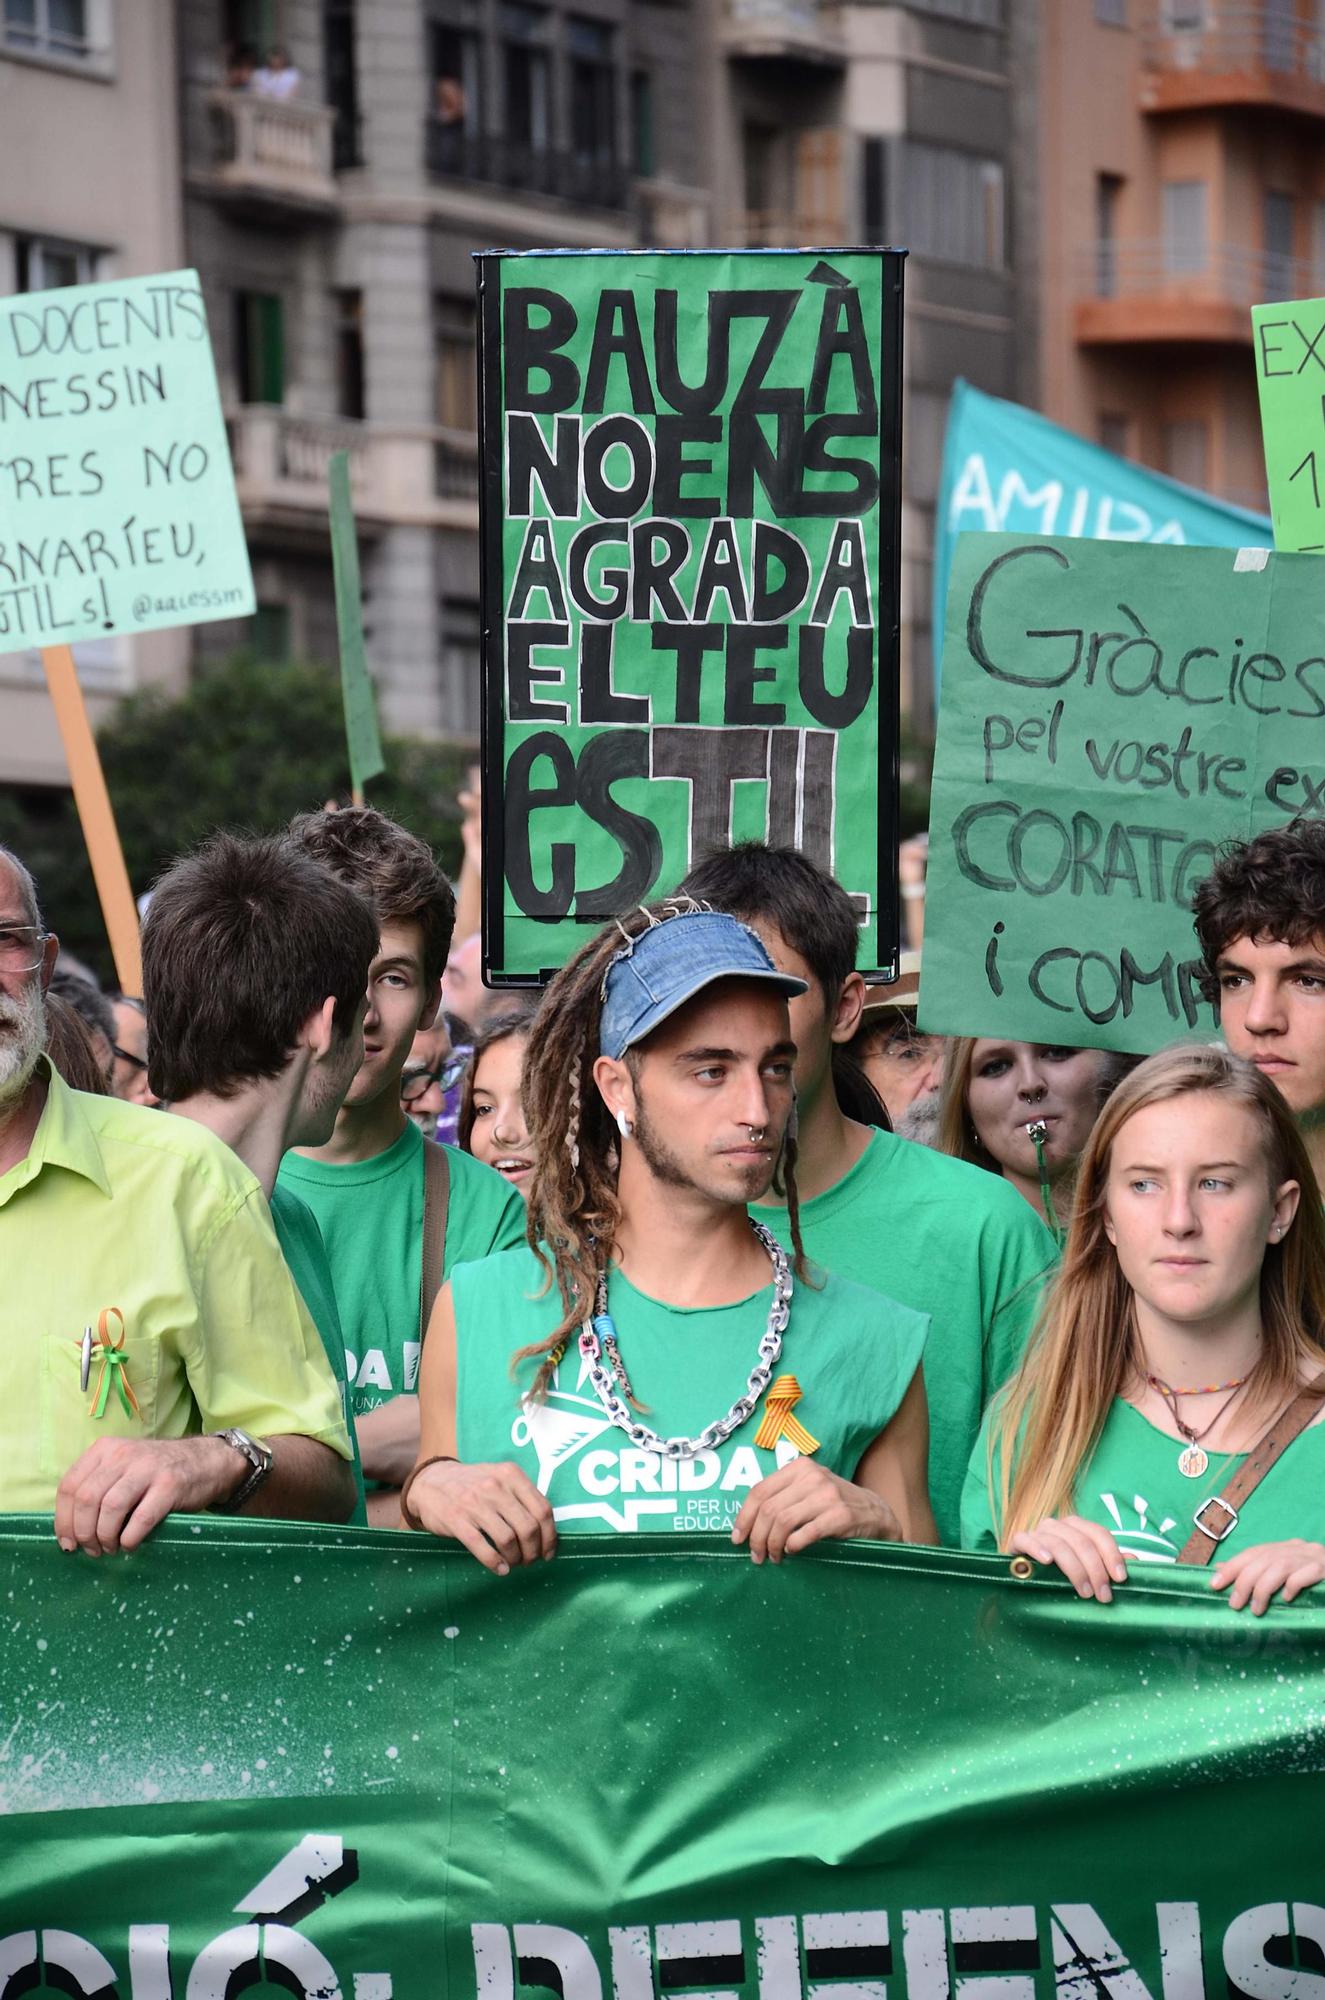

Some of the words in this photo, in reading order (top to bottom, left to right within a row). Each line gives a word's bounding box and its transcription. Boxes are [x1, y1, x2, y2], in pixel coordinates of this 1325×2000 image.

[10, 285, 207, 357] DOCENTS
[503, 261, 878, 416] BAUZÀ
[143, 441, 209, 488] NO
[504, 410, 656, 521] NO
[652, 412, 880, 520] ENS
[505, 517, 875, 628] AGRADA
[504, 621, 653, 727] EL
[651, 624, 875, 729] TEU
[967, 545, 1325, 718] Gràcies
[984, 700, 1064, 784] pel
[1085, 727, 1249, 799] vostre
[985, 922, 1005, 997] i
[1028, 947, 1221, 1030] COMP
[577, 1446, 765, 1497] CRIDA
[673, 1515, 735, 1531] EDUCA
[687, 1499, 720, 1514] PER
